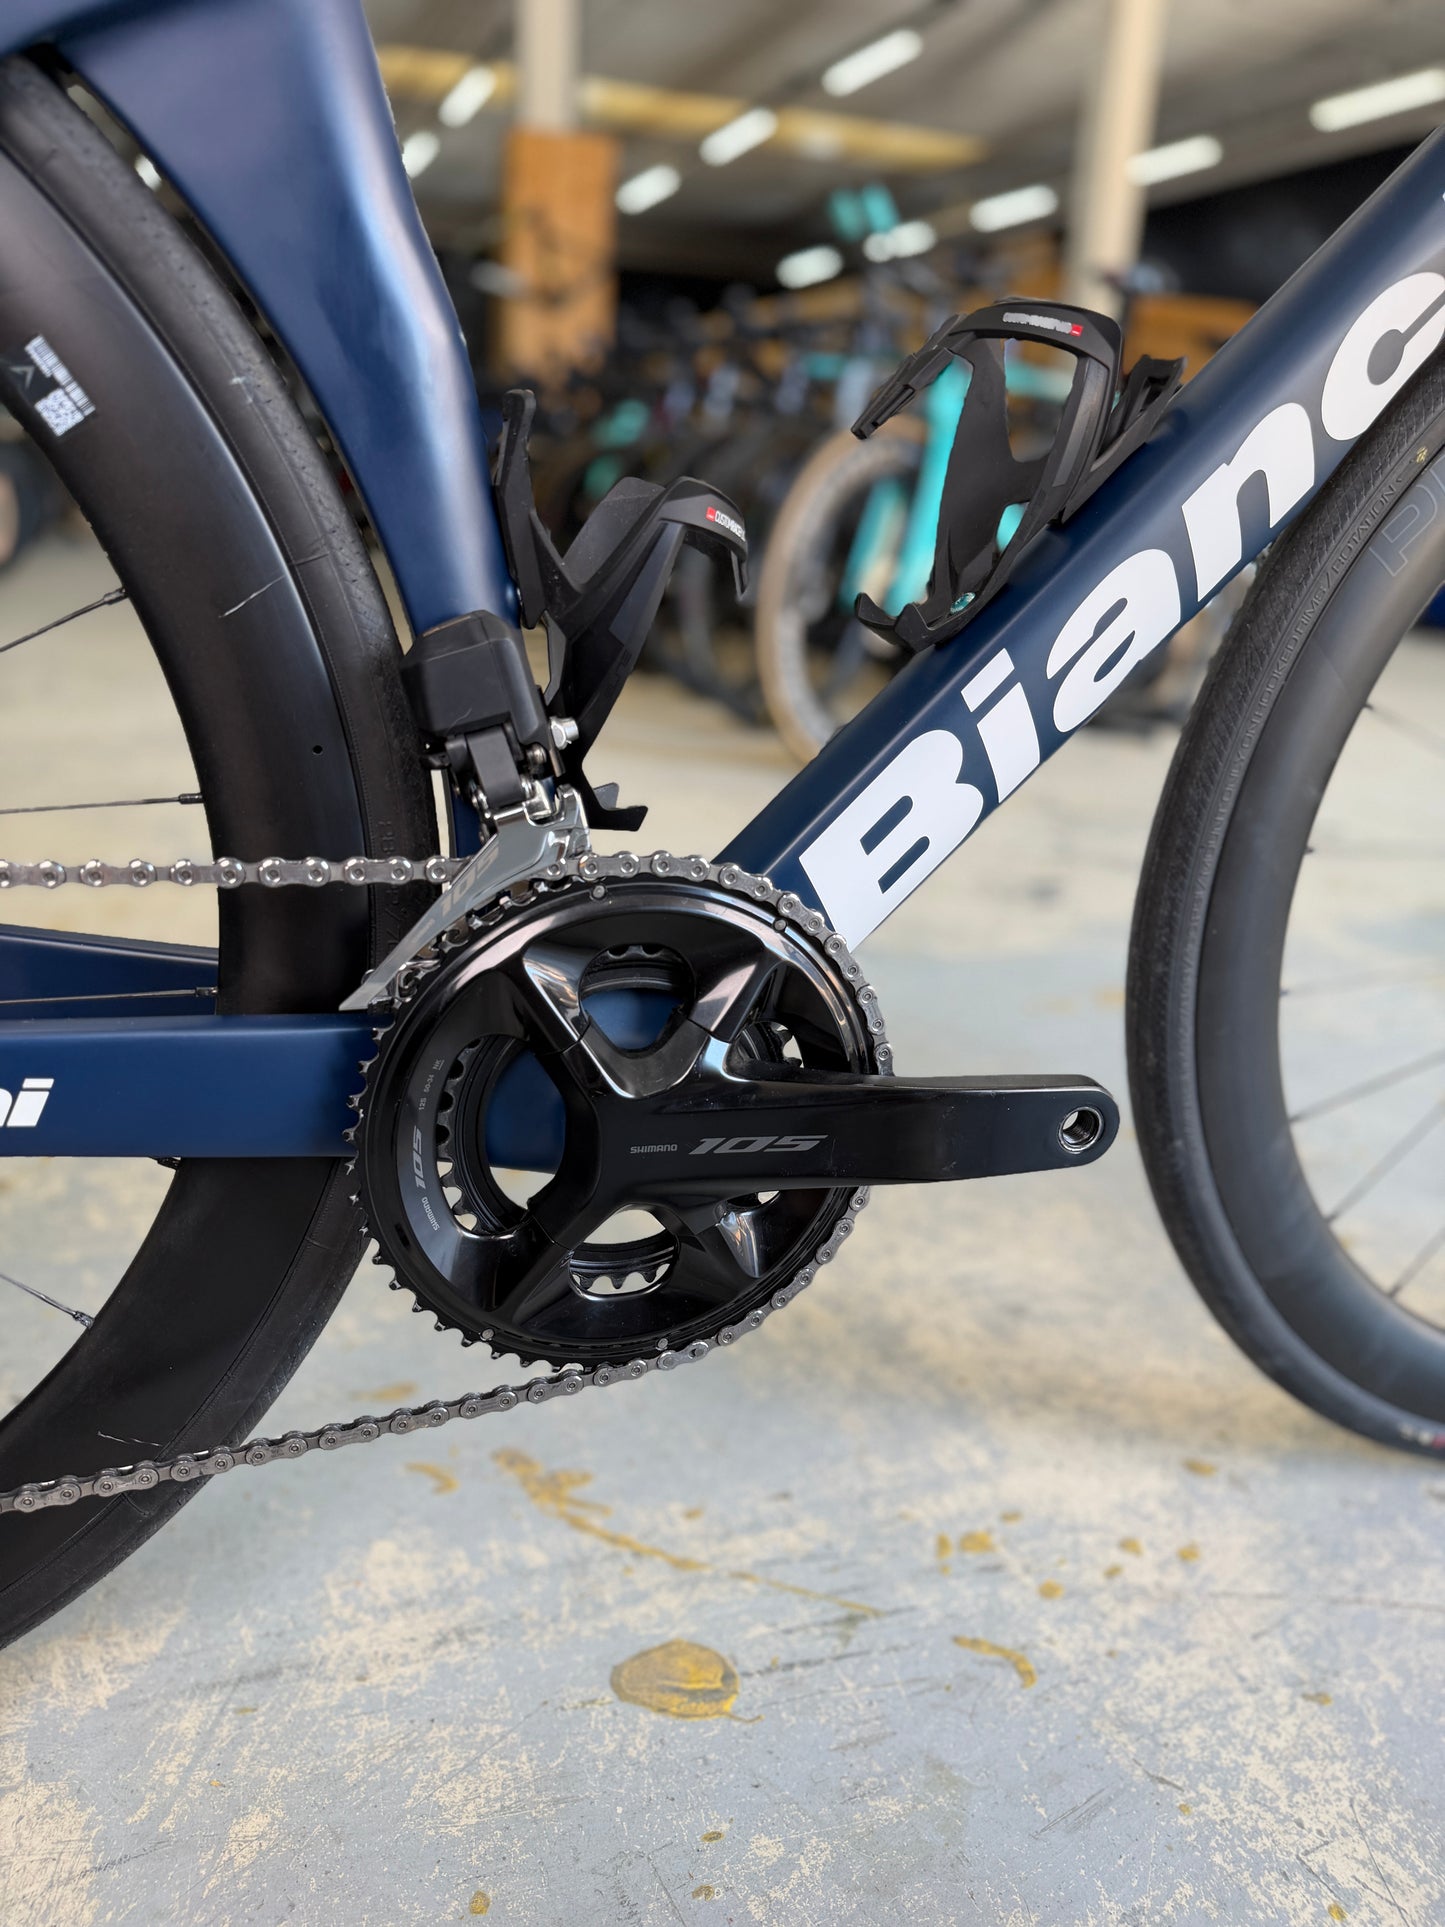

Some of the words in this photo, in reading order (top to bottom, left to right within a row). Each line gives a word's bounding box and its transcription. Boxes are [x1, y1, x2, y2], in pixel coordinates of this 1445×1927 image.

[1331, 483, 1397, 574] ROTATION
[413, 1125, 426, 1189] 105
[630, 1143, 678, 1154] SHIMANO
[688, 1134, 829, 1155] 105
[421, 1197, 440, 1230] SHIMANO
